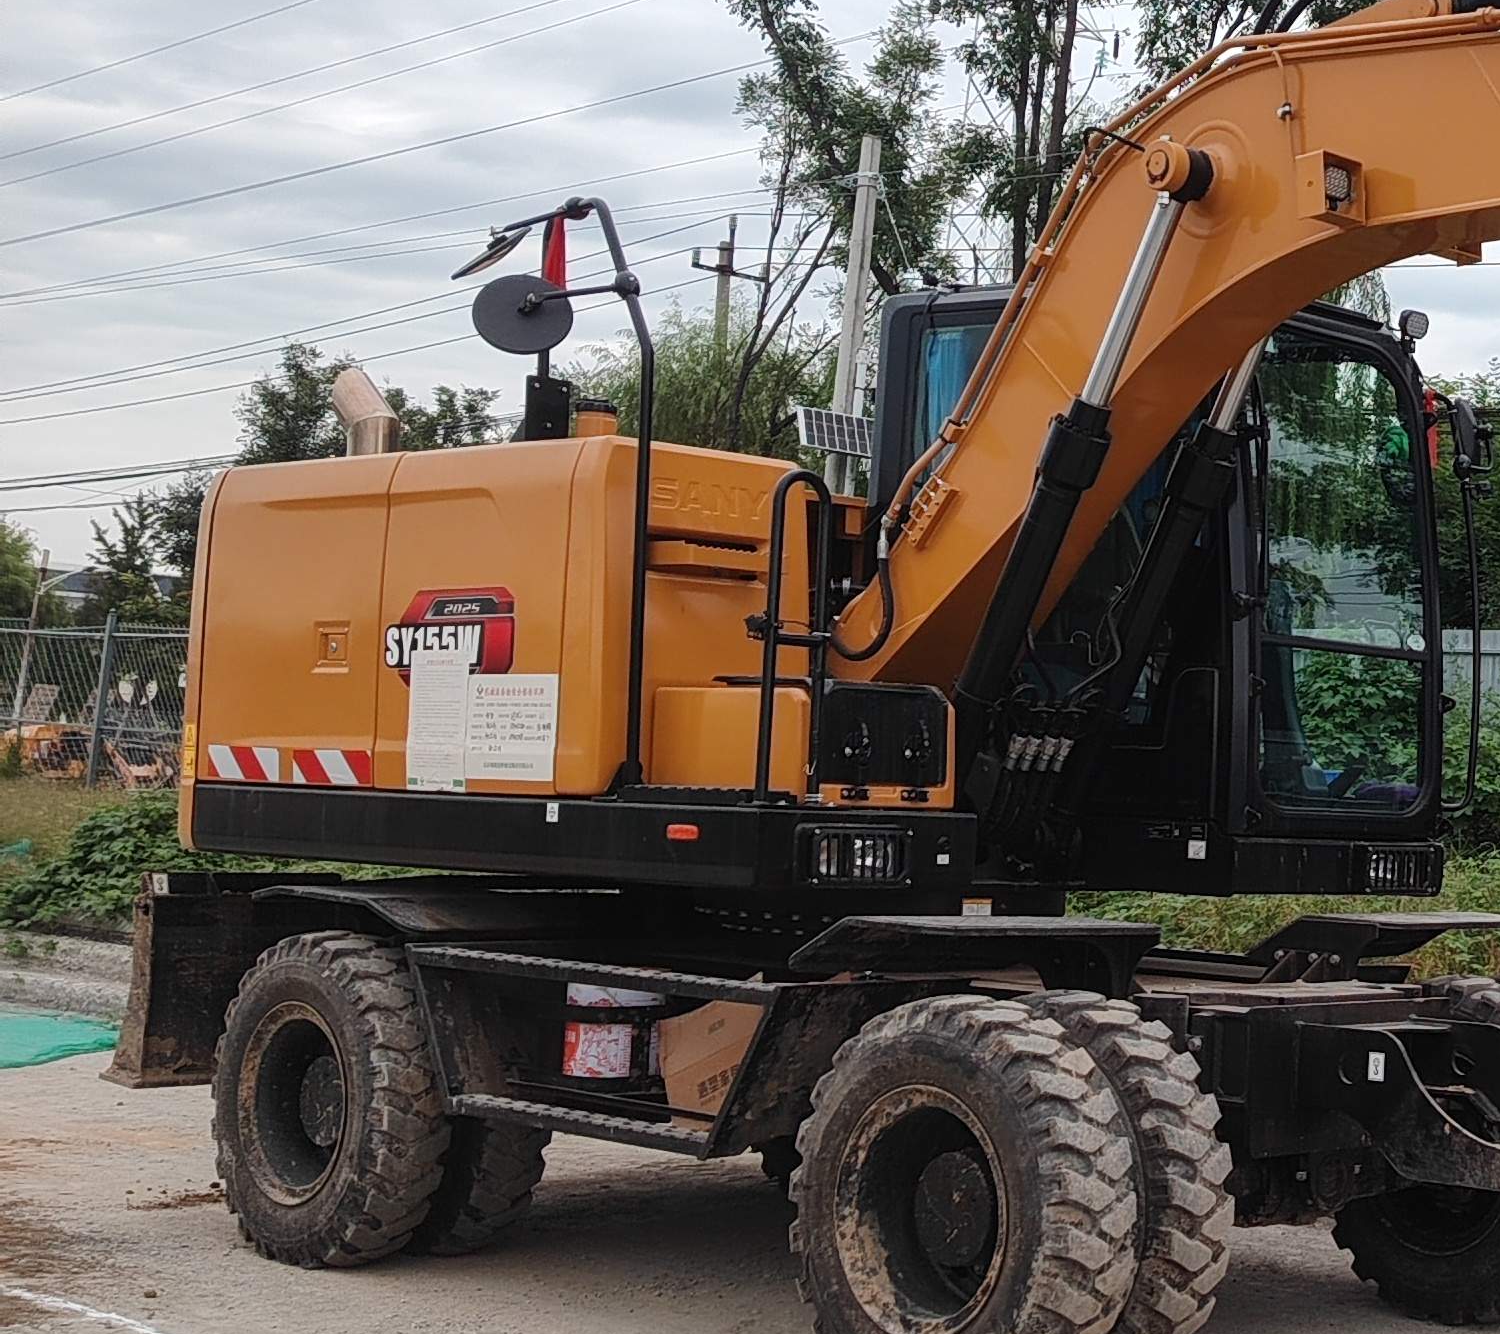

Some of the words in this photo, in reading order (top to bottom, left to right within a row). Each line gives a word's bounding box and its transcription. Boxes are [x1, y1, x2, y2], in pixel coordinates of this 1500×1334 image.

[652, 474, 769, 520] SANY
[443, 602, 481, 615] 2025
[385, 624, 482, 666] SY155W
